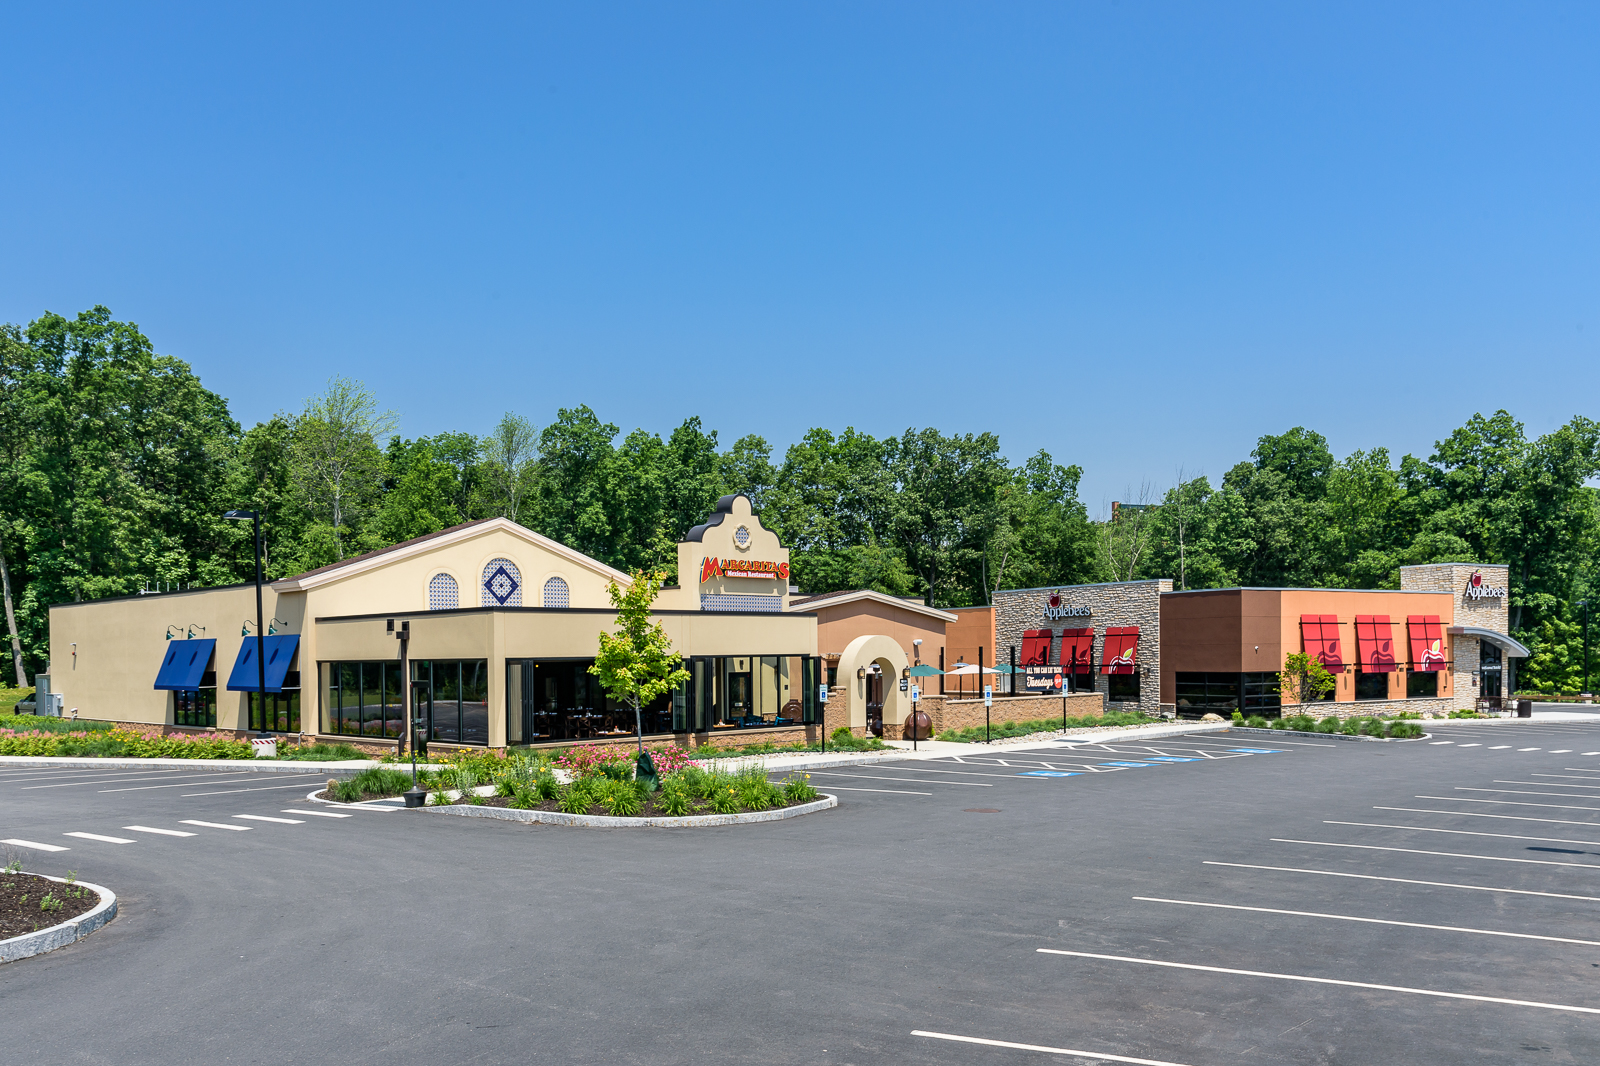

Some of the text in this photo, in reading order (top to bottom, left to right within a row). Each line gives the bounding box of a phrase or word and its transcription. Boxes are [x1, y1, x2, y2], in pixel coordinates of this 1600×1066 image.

[700, 556, 790, 583] MARGARITAS
[748, 570, 775, 579] Restaurant
[1465, 581, 1507, 600] Applebee's
[1042, 602, 1091, 620] Applebee's
[1026, 675, 1054, 690] Tuesdays
